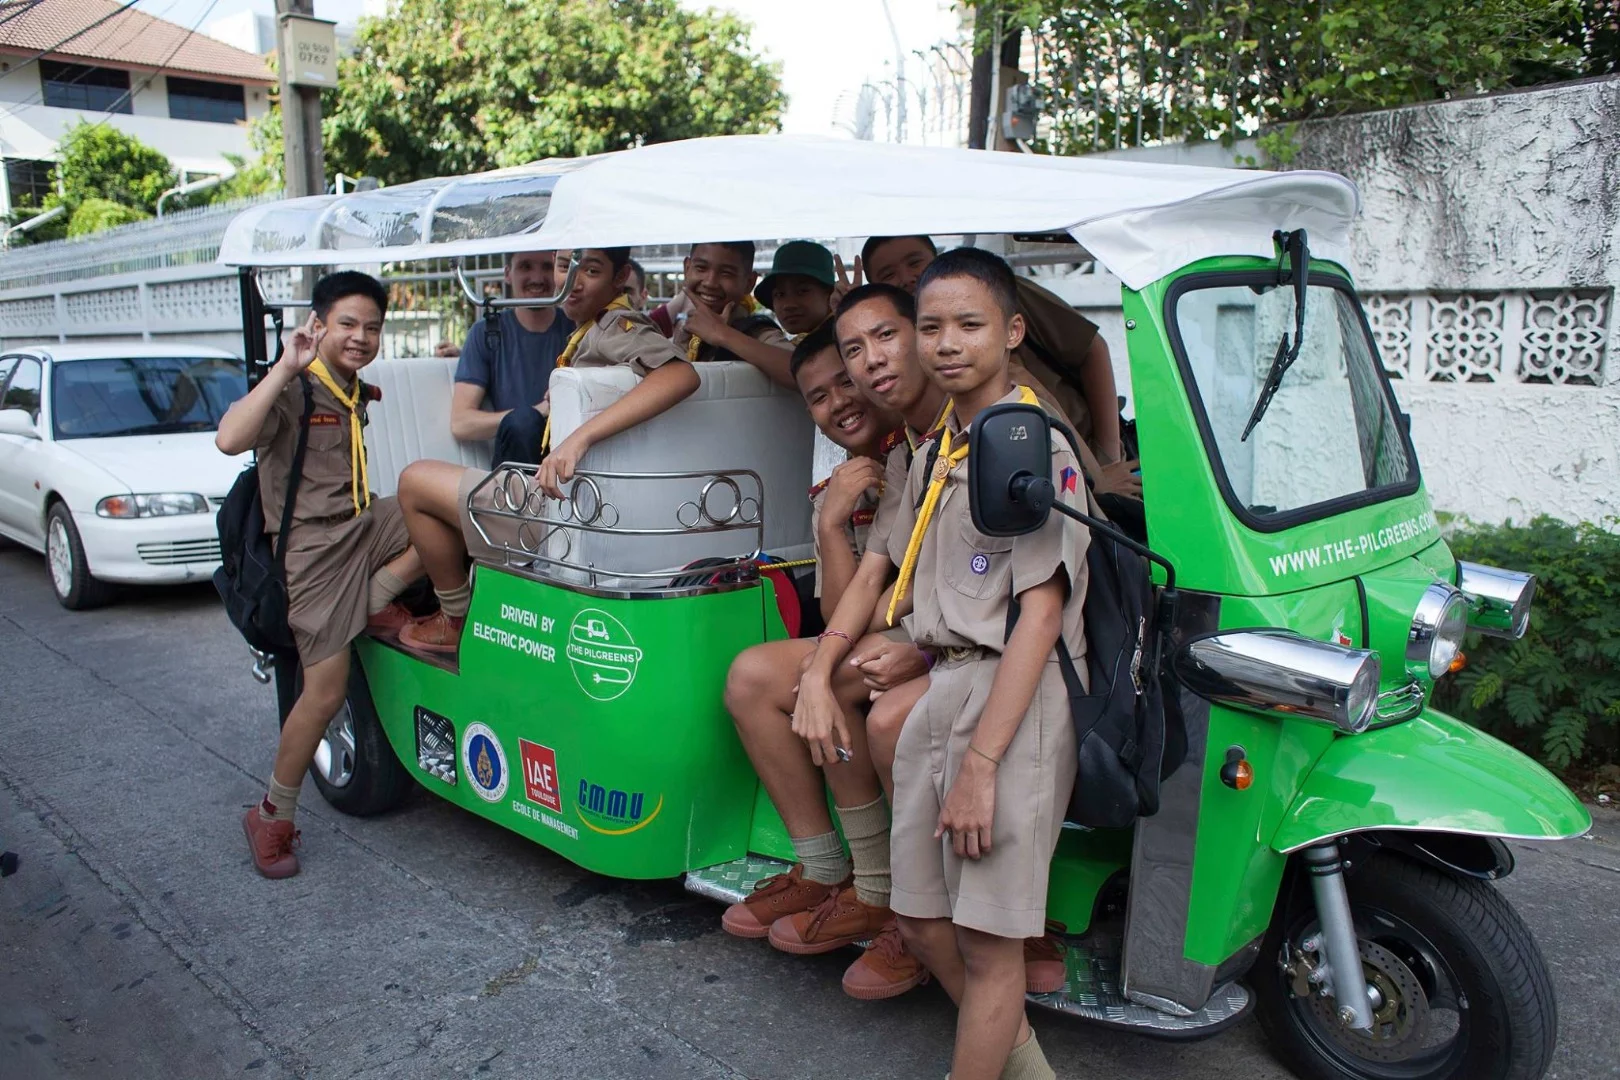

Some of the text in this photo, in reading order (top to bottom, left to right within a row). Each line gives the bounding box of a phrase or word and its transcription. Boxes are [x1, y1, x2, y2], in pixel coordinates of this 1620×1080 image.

[501, 603, 556, 634] DRIVEN BY
[473, 621, 556, 663] ELECTRIC POWER
[570, 643, 635, 663] THE PILGREENS
[526, 757, 553, 792] IAE
[578, 778, 644, 820] CMMU
[512, 800, 579, 840] ECOLE DE MANAGEMENT
